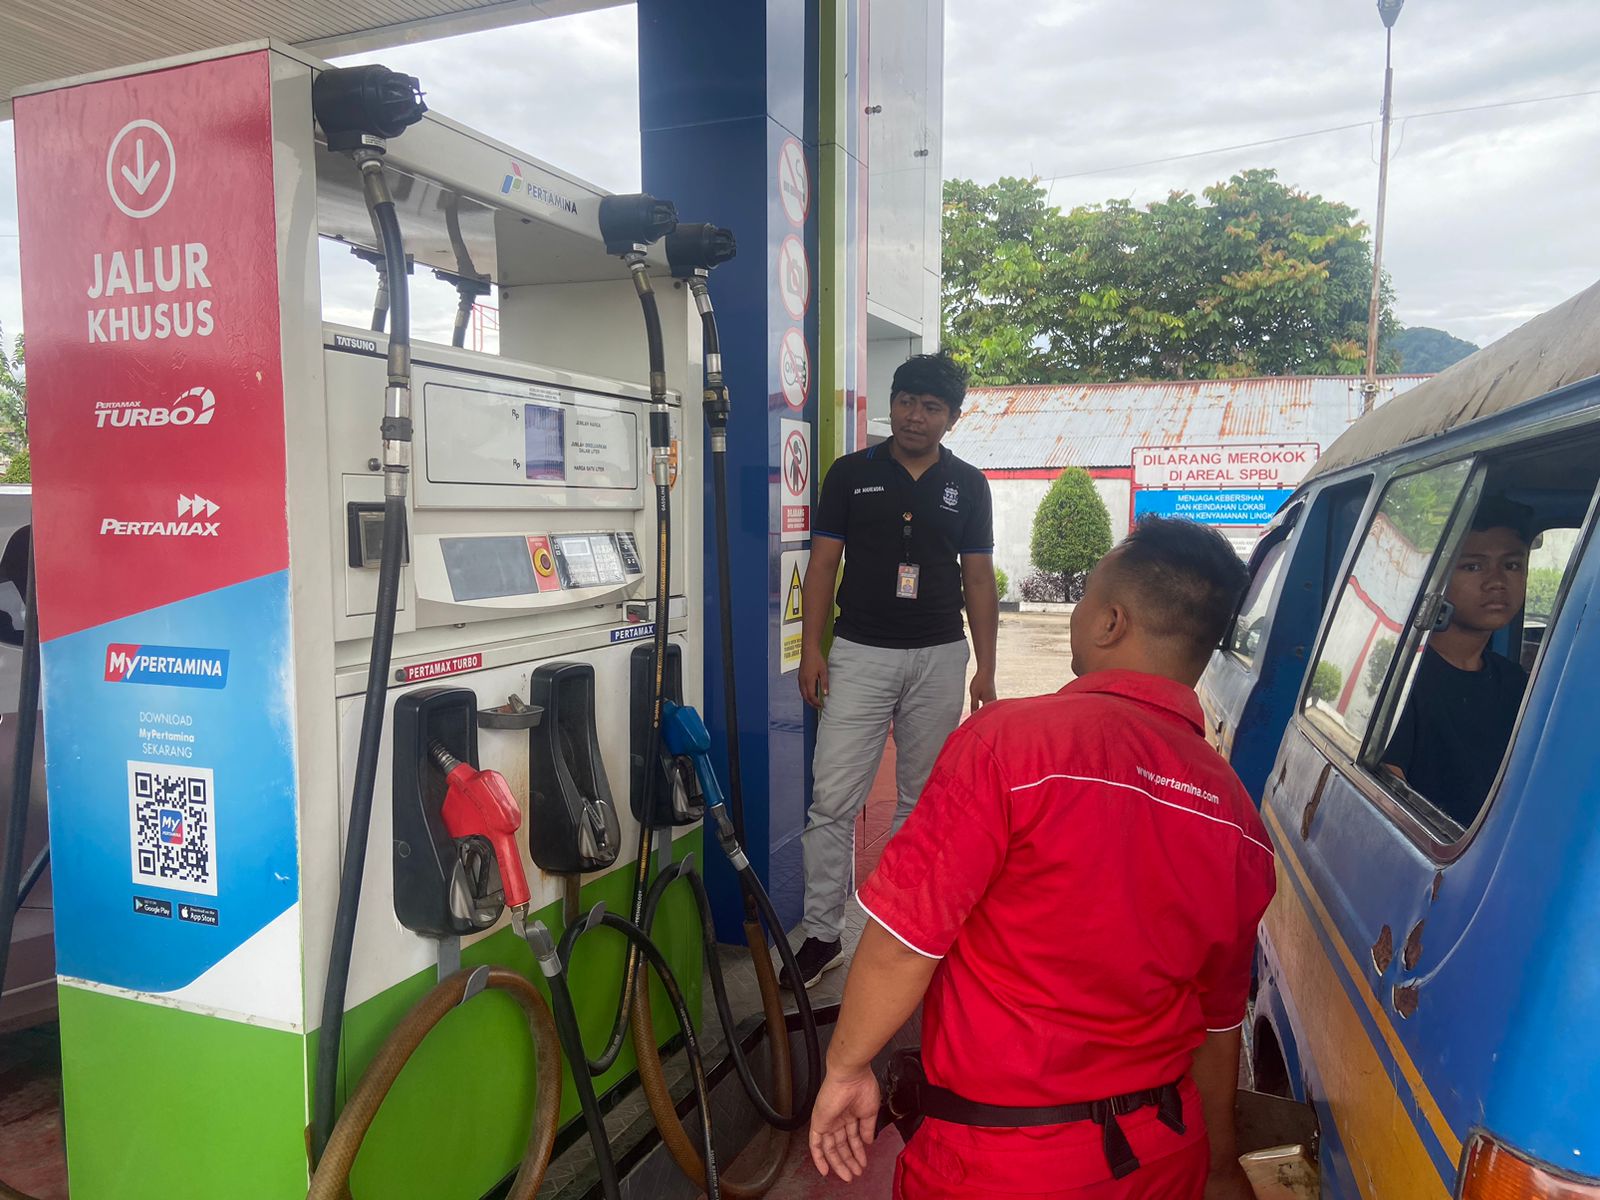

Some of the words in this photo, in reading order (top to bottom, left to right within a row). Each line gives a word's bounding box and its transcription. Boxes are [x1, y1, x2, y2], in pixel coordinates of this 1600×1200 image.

[527, 183, 578, 216] PERTAMINA
[87, 242, 212, 299] JALUR
[87, 300, 214, 343] KHUSUS
[336, 335, 375, 352] TATSUNO
[95, 400, 141, 409] PERTAMAX
[94, 407, 195, 428] TURBO
[1143, 453, 1222, 466] DILARANG
[1227, 451, 1306, 464] MEROKOK
[1169, 470, 1182, 481] DI
[1186, 470, 1234, 481] AREAL
[1239, 469, 1278, 480] SPBU
[1177, 494, 1214, 502] MENJAGA
[1175, 503, 1192, 511] DAN
[1192, 503, 1237, 511] KEINDAHAN
[1196, 512, 1248, 520] KENYAMANAN
[1250, 512, 1273, 520] LINGK
[99, 518, 221, 537] PERTAMAX
[615, 625, 654, 640] PERTAMAX
[408, 659, 452, 679] PERTAMAX
[452, 655, 478, 670] TURBO
[139, 711, 193, 727] DOWNLOAD
[138, 728, 195, 743] MyPertamina
[142, 744, 193, 758] SEKARANG
[1136, 765, 1220, 805] www.pertamina.com
[162, 816, 180, 832] My
[144, 904, 160, 914] Google
[160, 906, 170, 916] Play
[190, 912, 201, 922] App
[202, 914, 216, 924] Store
